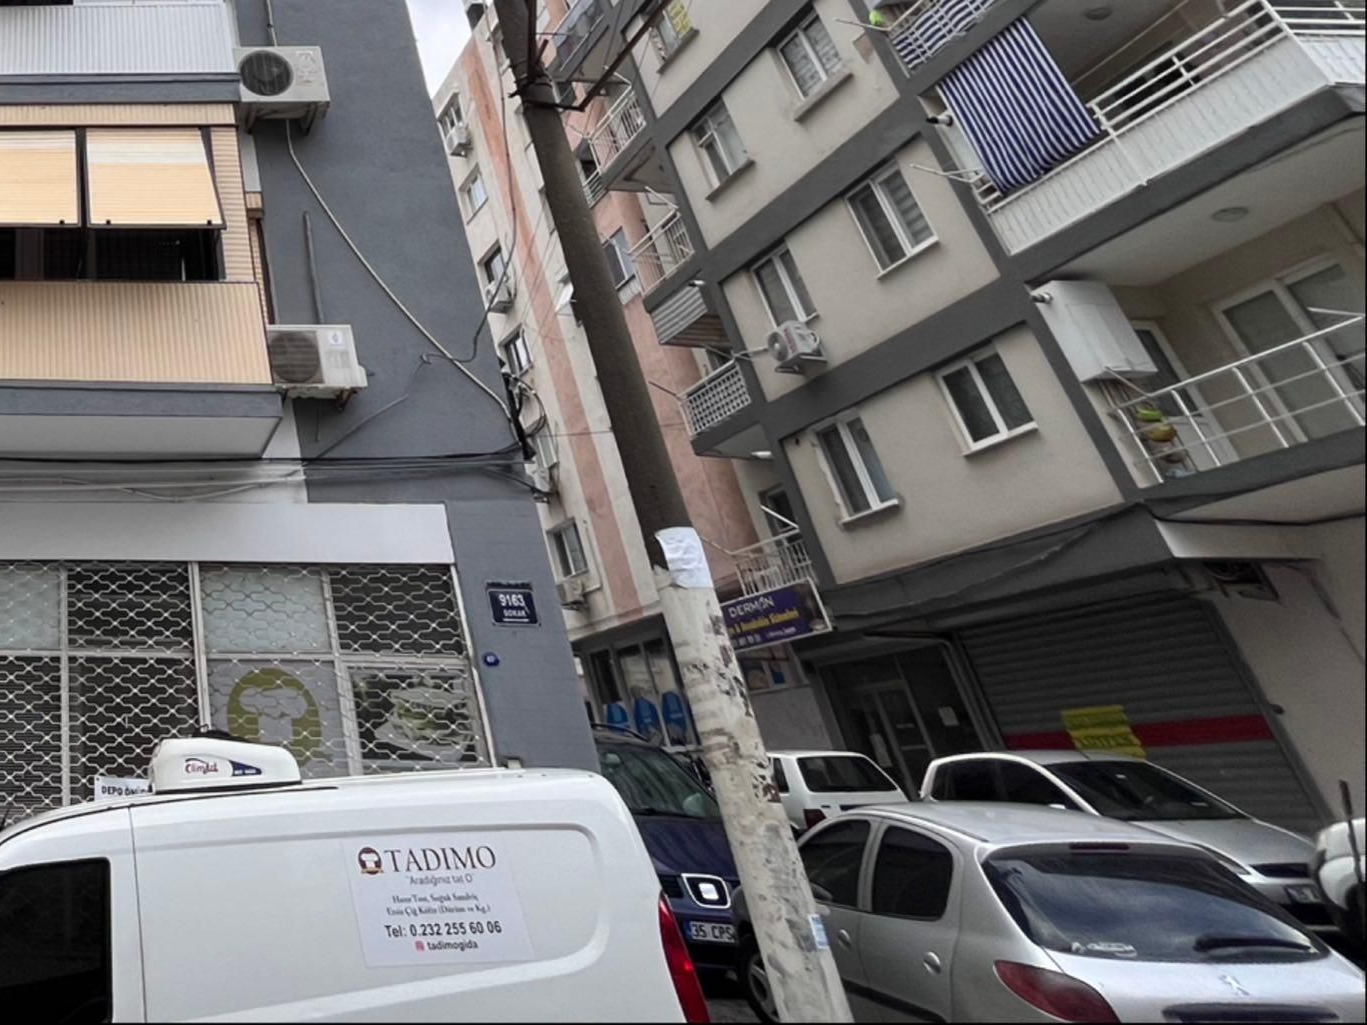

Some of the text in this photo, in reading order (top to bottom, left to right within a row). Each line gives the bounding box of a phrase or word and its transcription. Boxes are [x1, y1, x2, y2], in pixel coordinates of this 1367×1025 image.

[498, 594, 525, 607] 9163
[101, 785, 124, 796] DEPO
[384, 846, 497, 873] TADIMO
[384, 920, 502, 938] Tel: 0.232 255 60 06
[691, 924, 707, 938] 35
[427, 939, 479, 952] tadimogida
